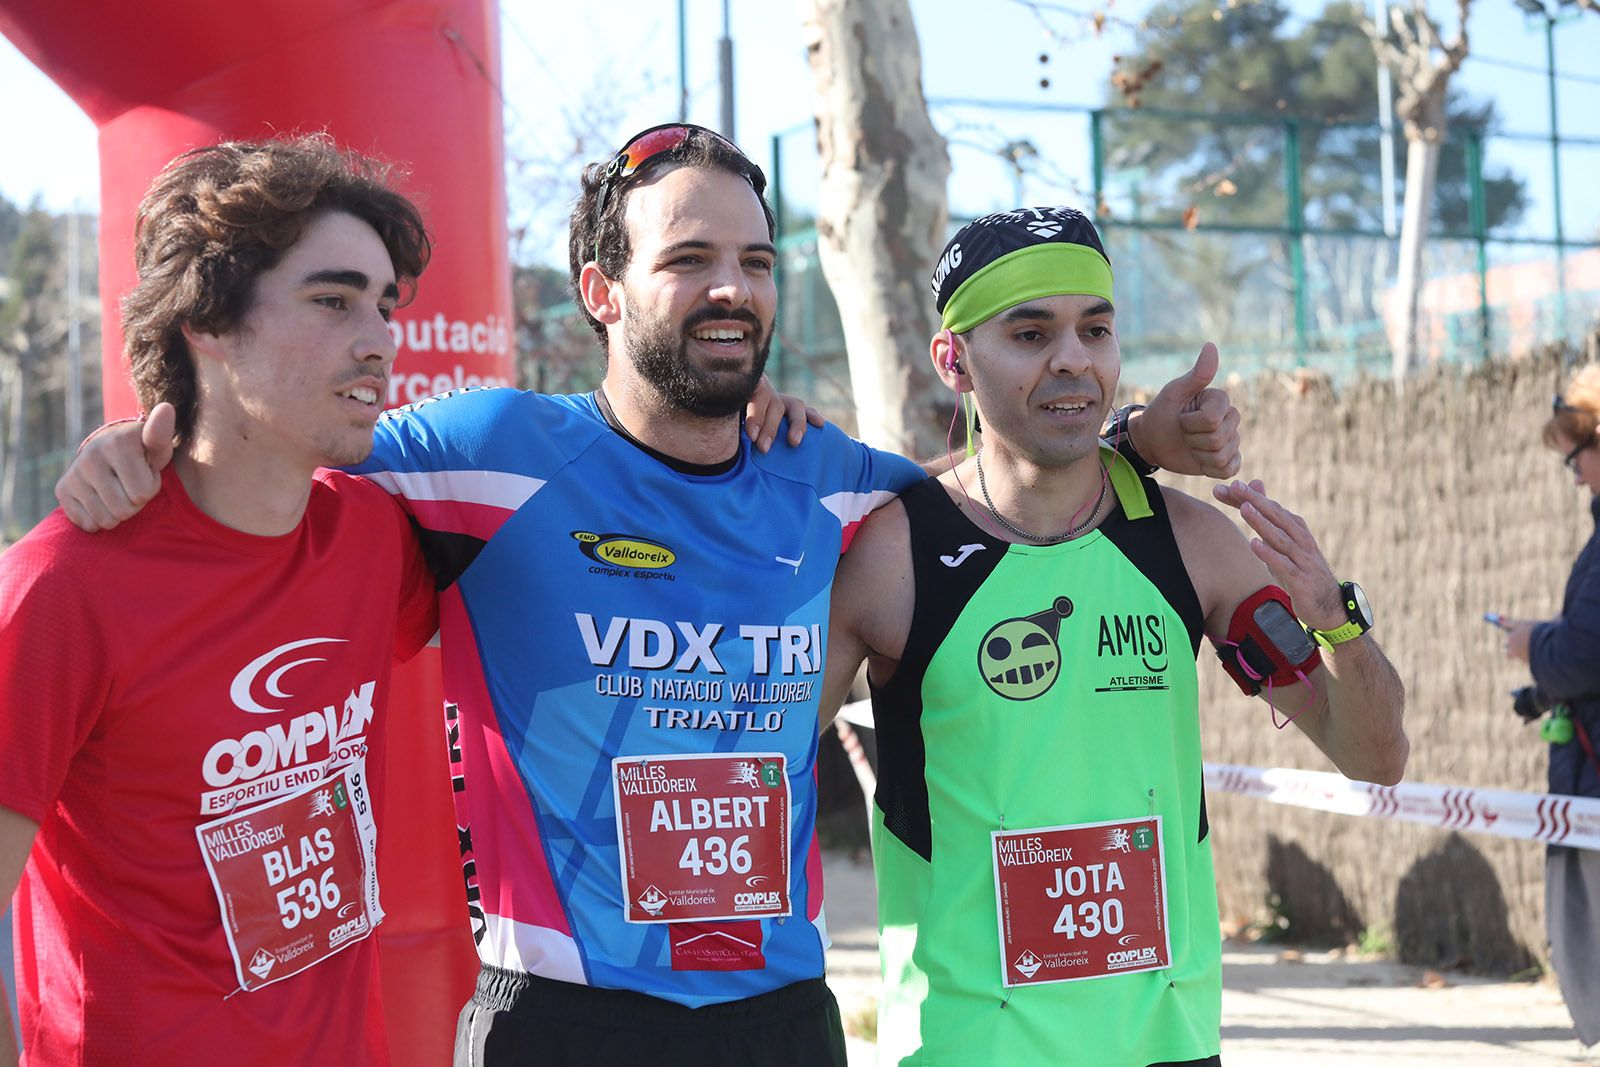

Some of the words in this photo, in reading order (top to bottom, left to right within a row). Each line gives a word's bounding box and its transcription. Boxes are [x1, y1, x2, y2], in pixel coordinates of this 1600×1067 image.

[605, 546, 669, 563] Valldoreix
[588, 566, 630, 579] complex
[634, 570, 675, 581] esportiu
[575, 612, 726, 675] VDX
[739, 623, 822, 675] TRI
[595, 674, 643, 698] CLUB
[650, 678, 725, 702] NATACIÓ
[729, 680, 814, 704] VALLDOREIX
[1109, 675, 1164, 686] ATLETISME
[643, 706, 787, 733] TRIATLÓ
[619, 766, 666, 782] MILLES
[621, 778, 697, 796] VALLDOREIX
[768, 769, 775, 781] 1
[209, 778, 280, 810] ESPORTIU
[285, 769, 320, 787] EMD
[351, 773, 367, 815] 536
[649, 795, 769, 832] ALBERT
[204, 820, 253, 849] MILLES
[209, 824, 285, 862] VALLDOREIX
[998, 837, 1042, 854] MILLES
[1138, 833, 1145, 844] 1
[262, 827, 335, 886] BLAS
[679, 835, 752, 877] 436
[1000, 847, 1073, 867] VALLDOREIX
[1045, 862, 1126, 899] JOTA
[276, 867, 341, 929] 536
[669, 894, 716, 906] Valldoreix
[734, 891, 781, 905] COMPLEX
[329, 911, 369, 940] COMPLE
[1053, 898, 1125, 940] 430
[1043, 956, 1089, 968] Valldoreix
[1106, 946, 1157, 964] COMPLEX
